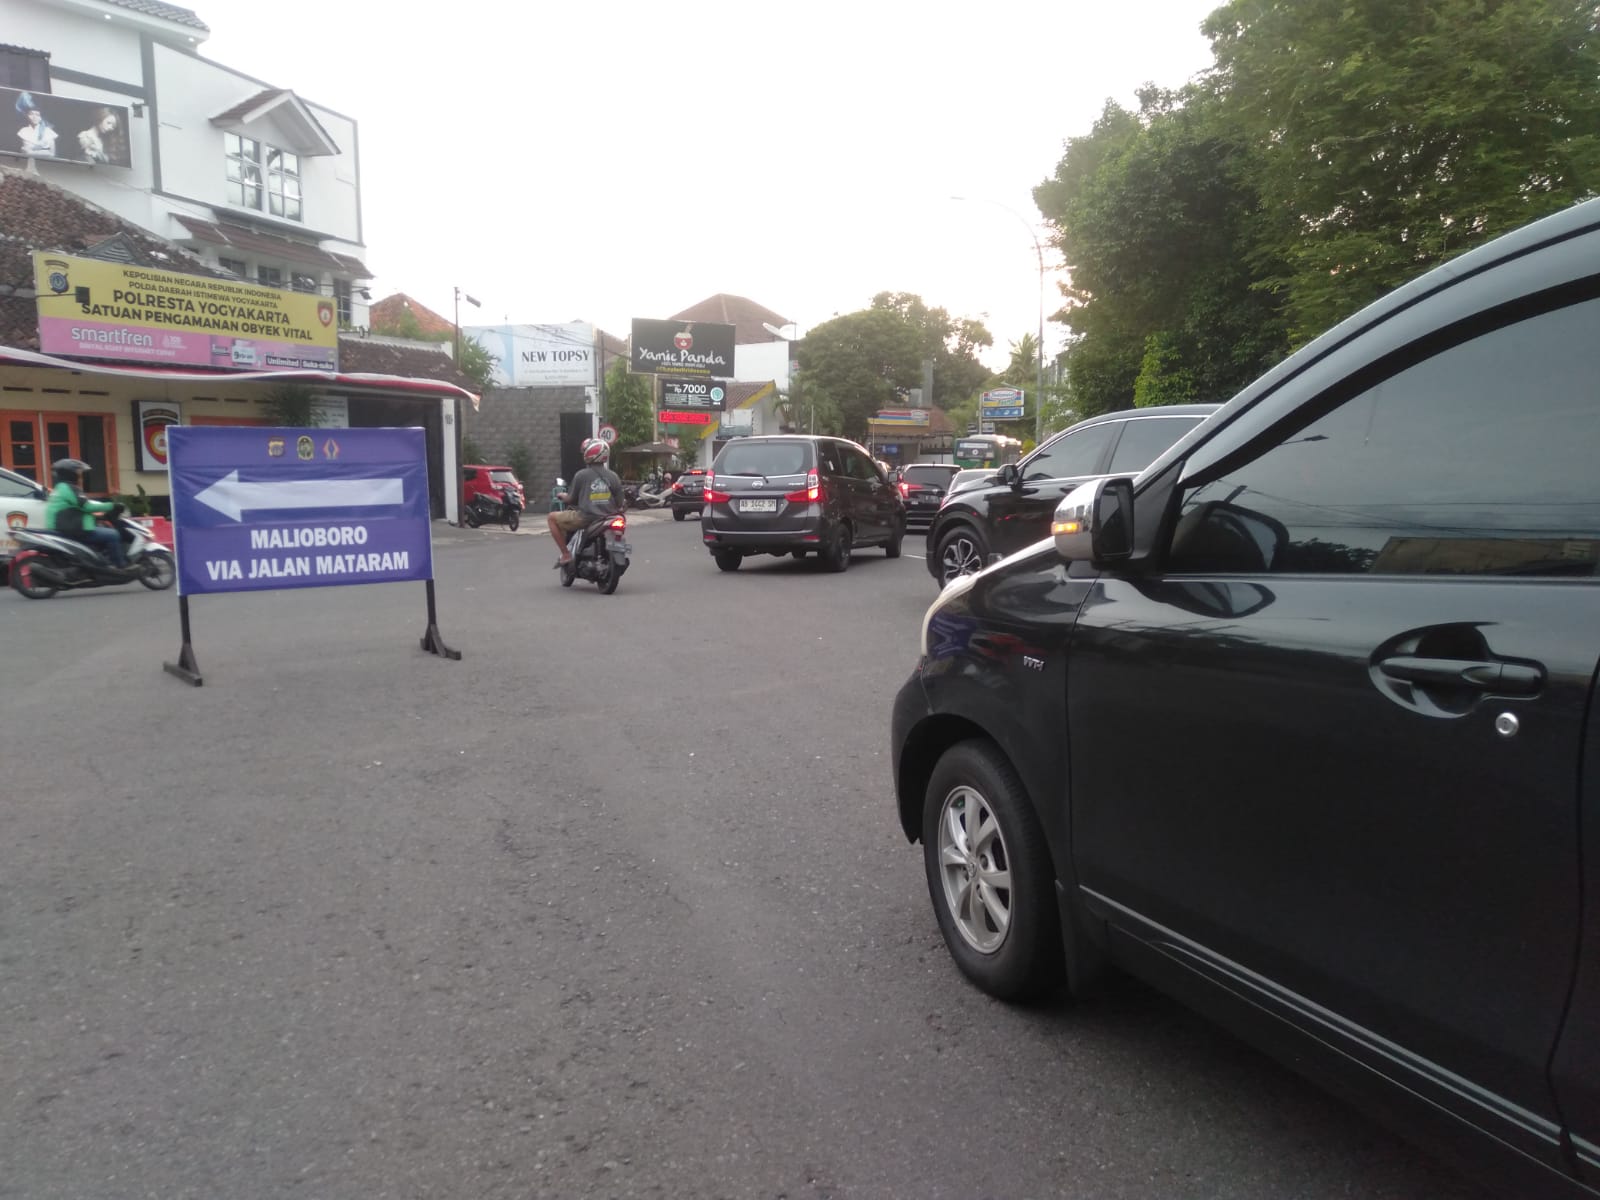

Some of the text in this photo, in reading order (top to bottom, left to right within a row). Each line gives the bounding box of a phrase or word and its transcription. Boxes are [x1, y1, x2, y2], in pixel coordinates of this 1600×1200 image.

[123, 270, 282, 300] KEPOLISIAN NEGARA REPUBLIK INDONESIA
[129, 281, 278, 308] POLDA DAERAH ISTIMEWA YOGYAKARTA
[113, 289, 291, 325] POLRESTA YOGYAKARTA
[81, 303, 313, 340] SATUAN PENGAMANAN OBYEK VITAL
[71, 327, 153, 347] smartfren
[521, 350, 590, 363] NEW TOPSY
[680, 349, 726, 365] Panda
[683, 383, 707, 394] 7000
[601, 430, 612, 441] 40
[250, 525, 368, 549] MALIOBORO
[206, 551, 409, 581] VIA JALAN MATARAM
